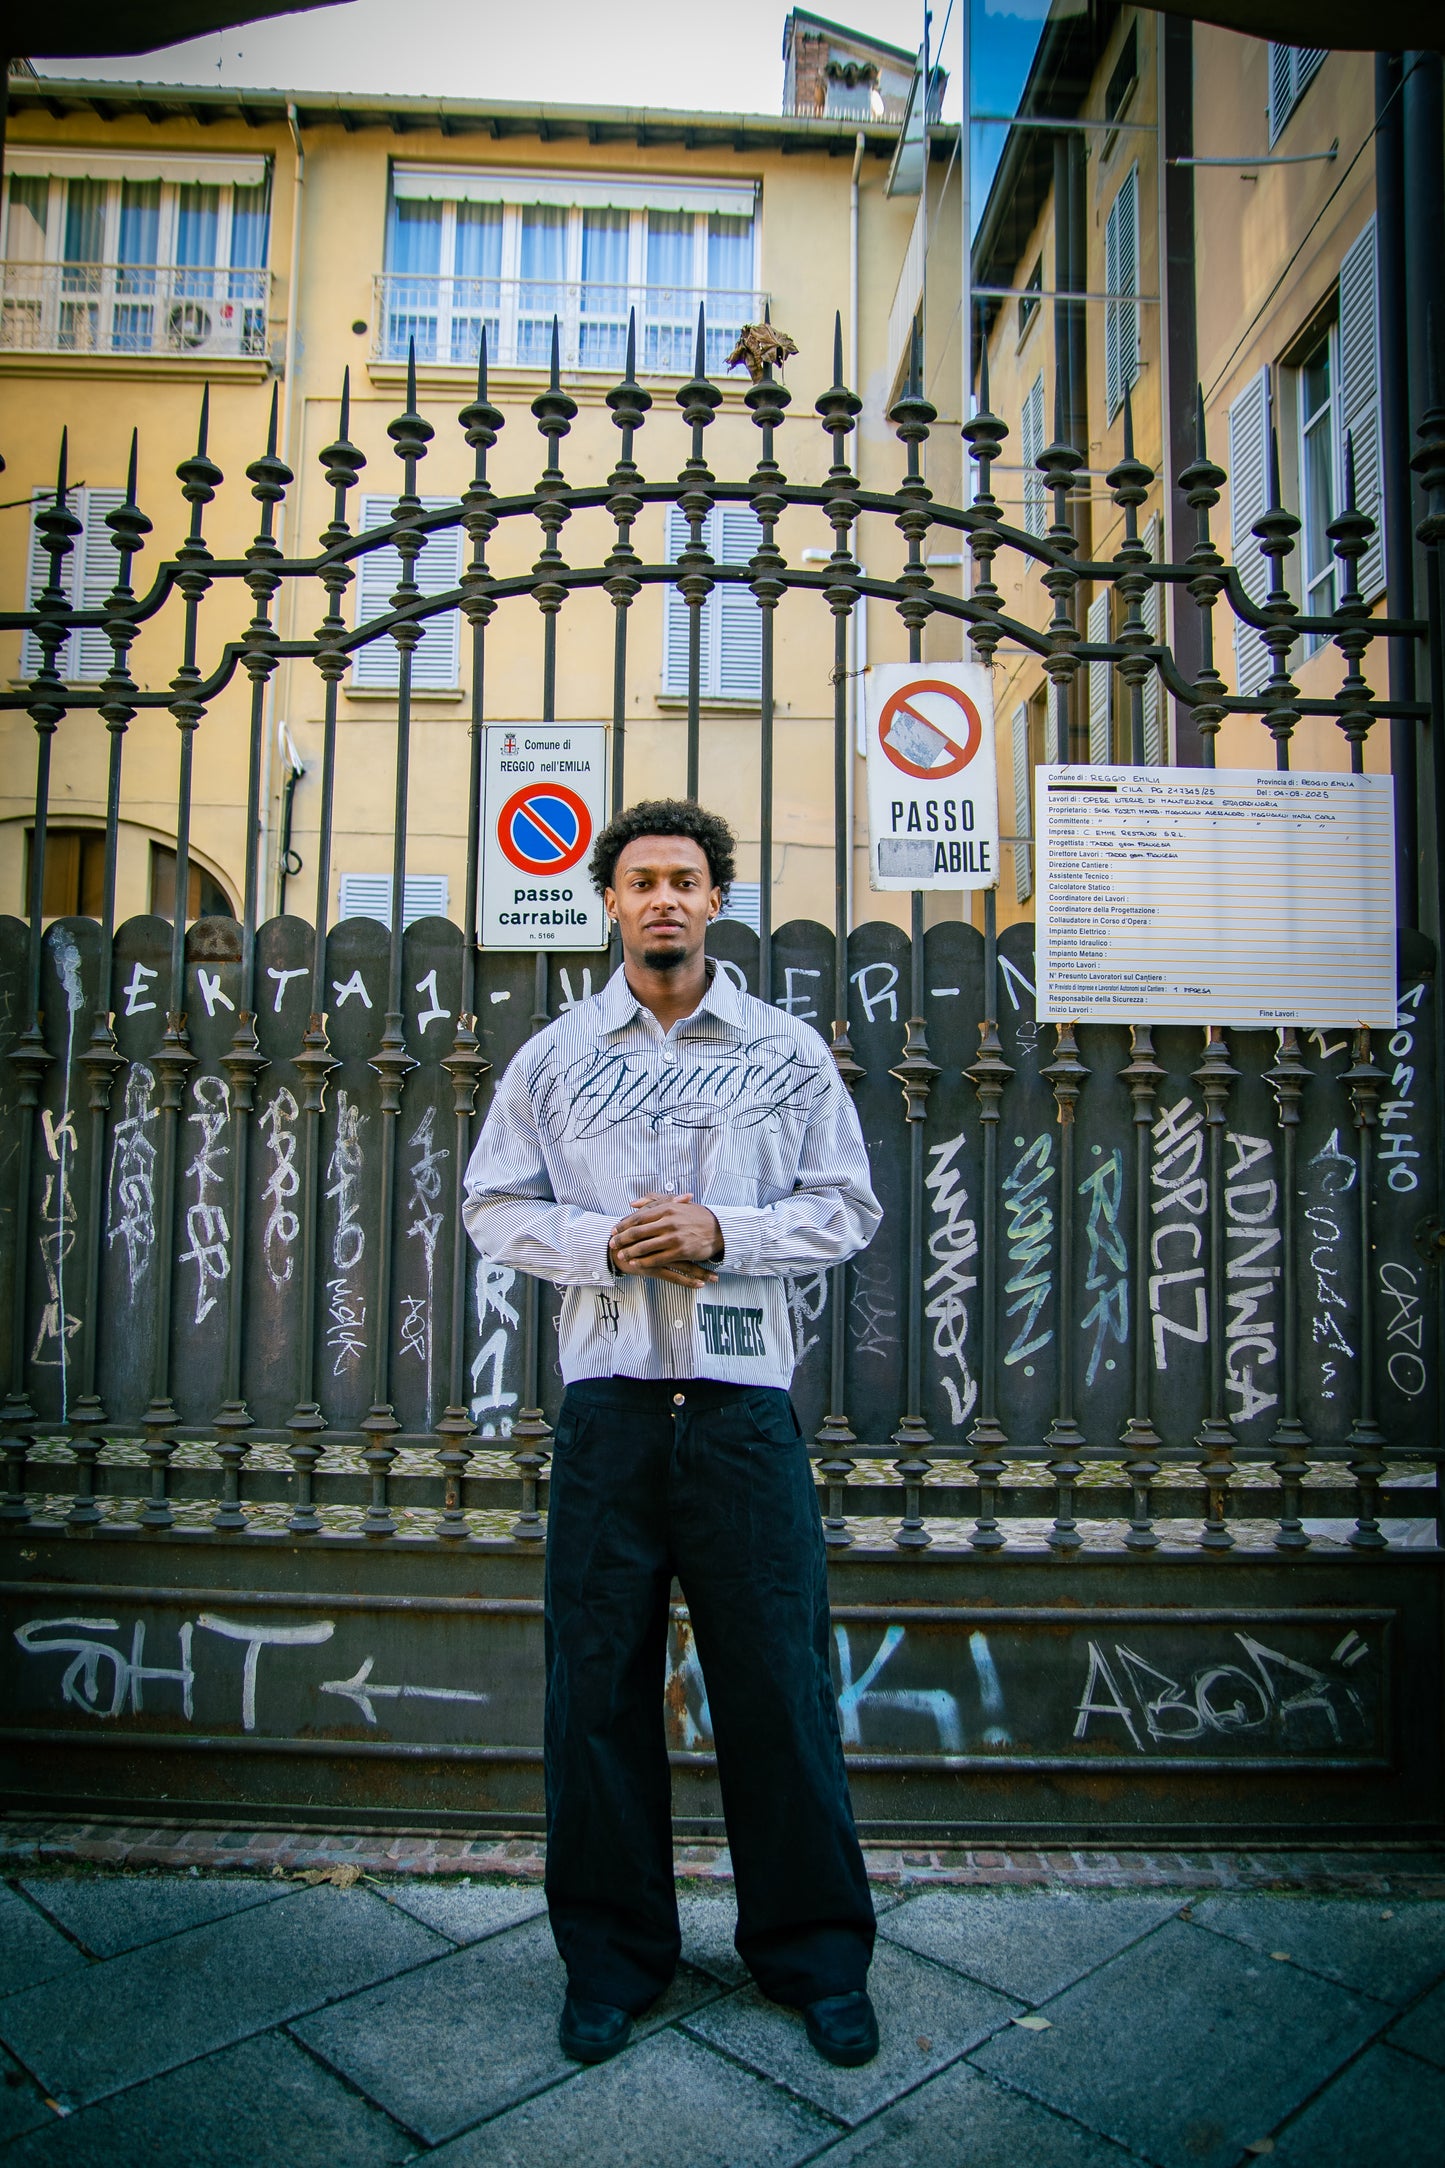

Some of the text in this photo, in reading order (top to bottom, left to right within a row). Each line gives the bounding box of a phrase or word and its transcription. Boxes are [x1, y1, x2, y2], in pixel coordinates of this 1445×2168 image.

[524, 739, 571, 749] Comune di
[500, 761, 590, 772] REGGIO nell'EMILIA
[1257, 778, 1287, 786] Provincia
[1151, 786, 1163, 794] PG
[1083, 796, 1110, 804] OPERE
[892, 800, 975, 832] PASSO
[1049, 872, 1082, 880] Assistente
[514, 889, 573, 904] passo
[499, 909, 587, 924] carrabile
[1049, 916, 1090, 924] Collaudatore
[1049, 928, 1078, 936] Impianto
[1049, 950, 1078, 958] Impianto
[1049, 961, 1074, 969] Importo
[1058, 972, 1087, 980] Presunto
[1077, 984, 1094, 992] Imprese
[1049, 995, 1093, 1003] Responsabile
